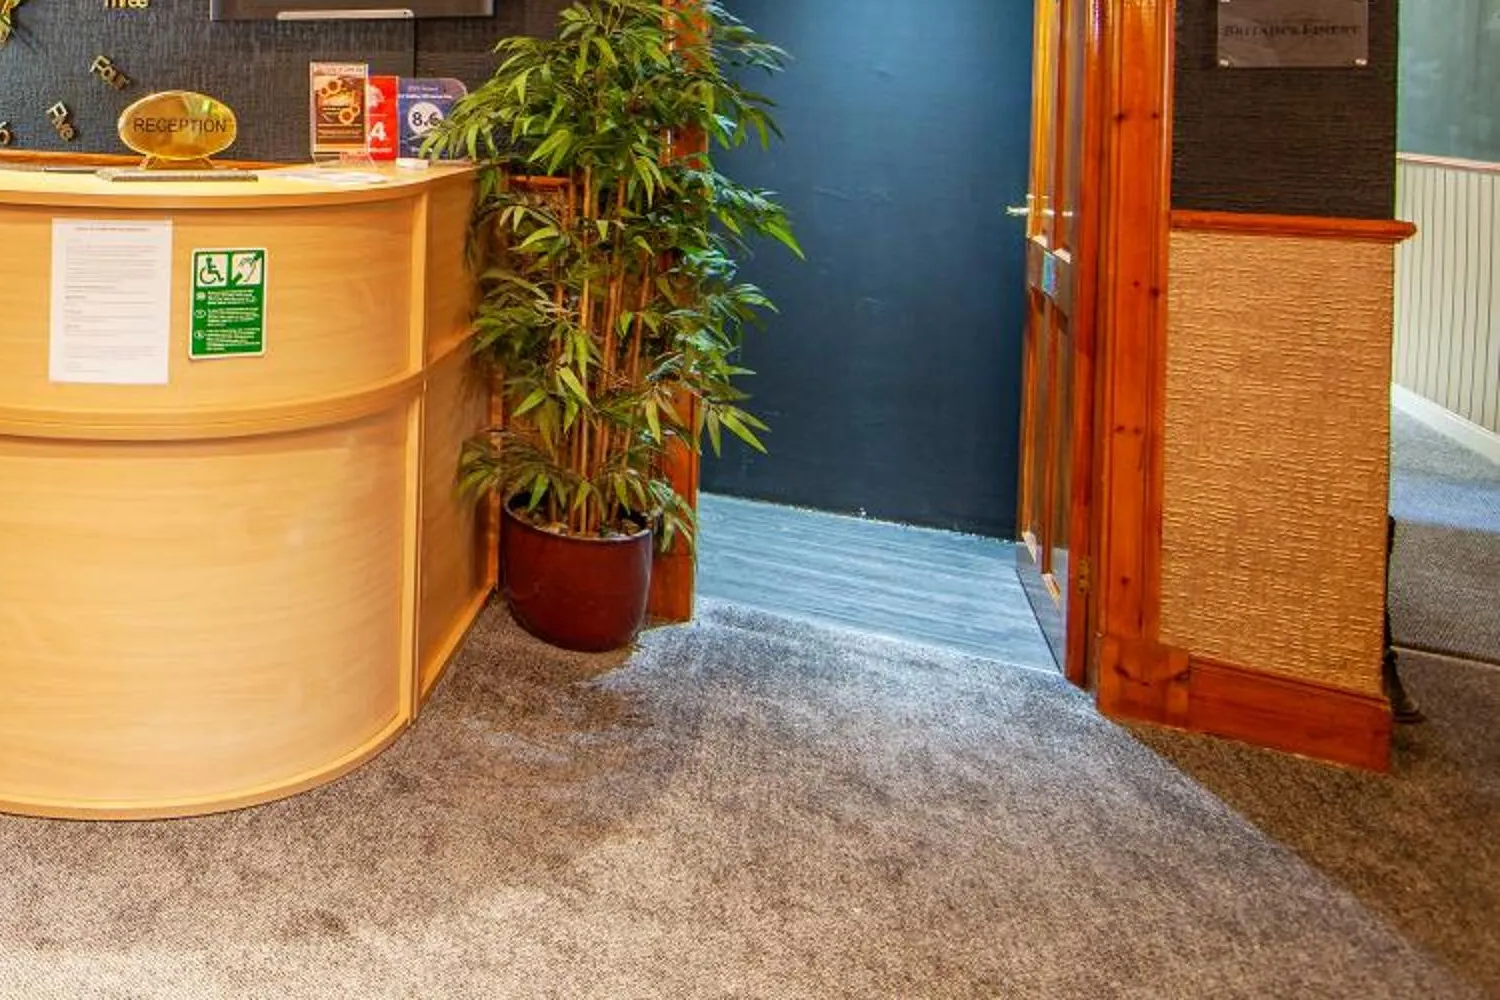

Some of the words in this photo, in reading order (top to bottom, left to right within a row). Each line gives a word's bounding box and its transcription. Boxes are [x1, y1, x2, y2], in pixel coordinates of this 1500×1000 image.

[89, 55, 130, 90] Four
[46, 100, 74, 141] Five
[133, 117, 228, 133] RECEPTION
